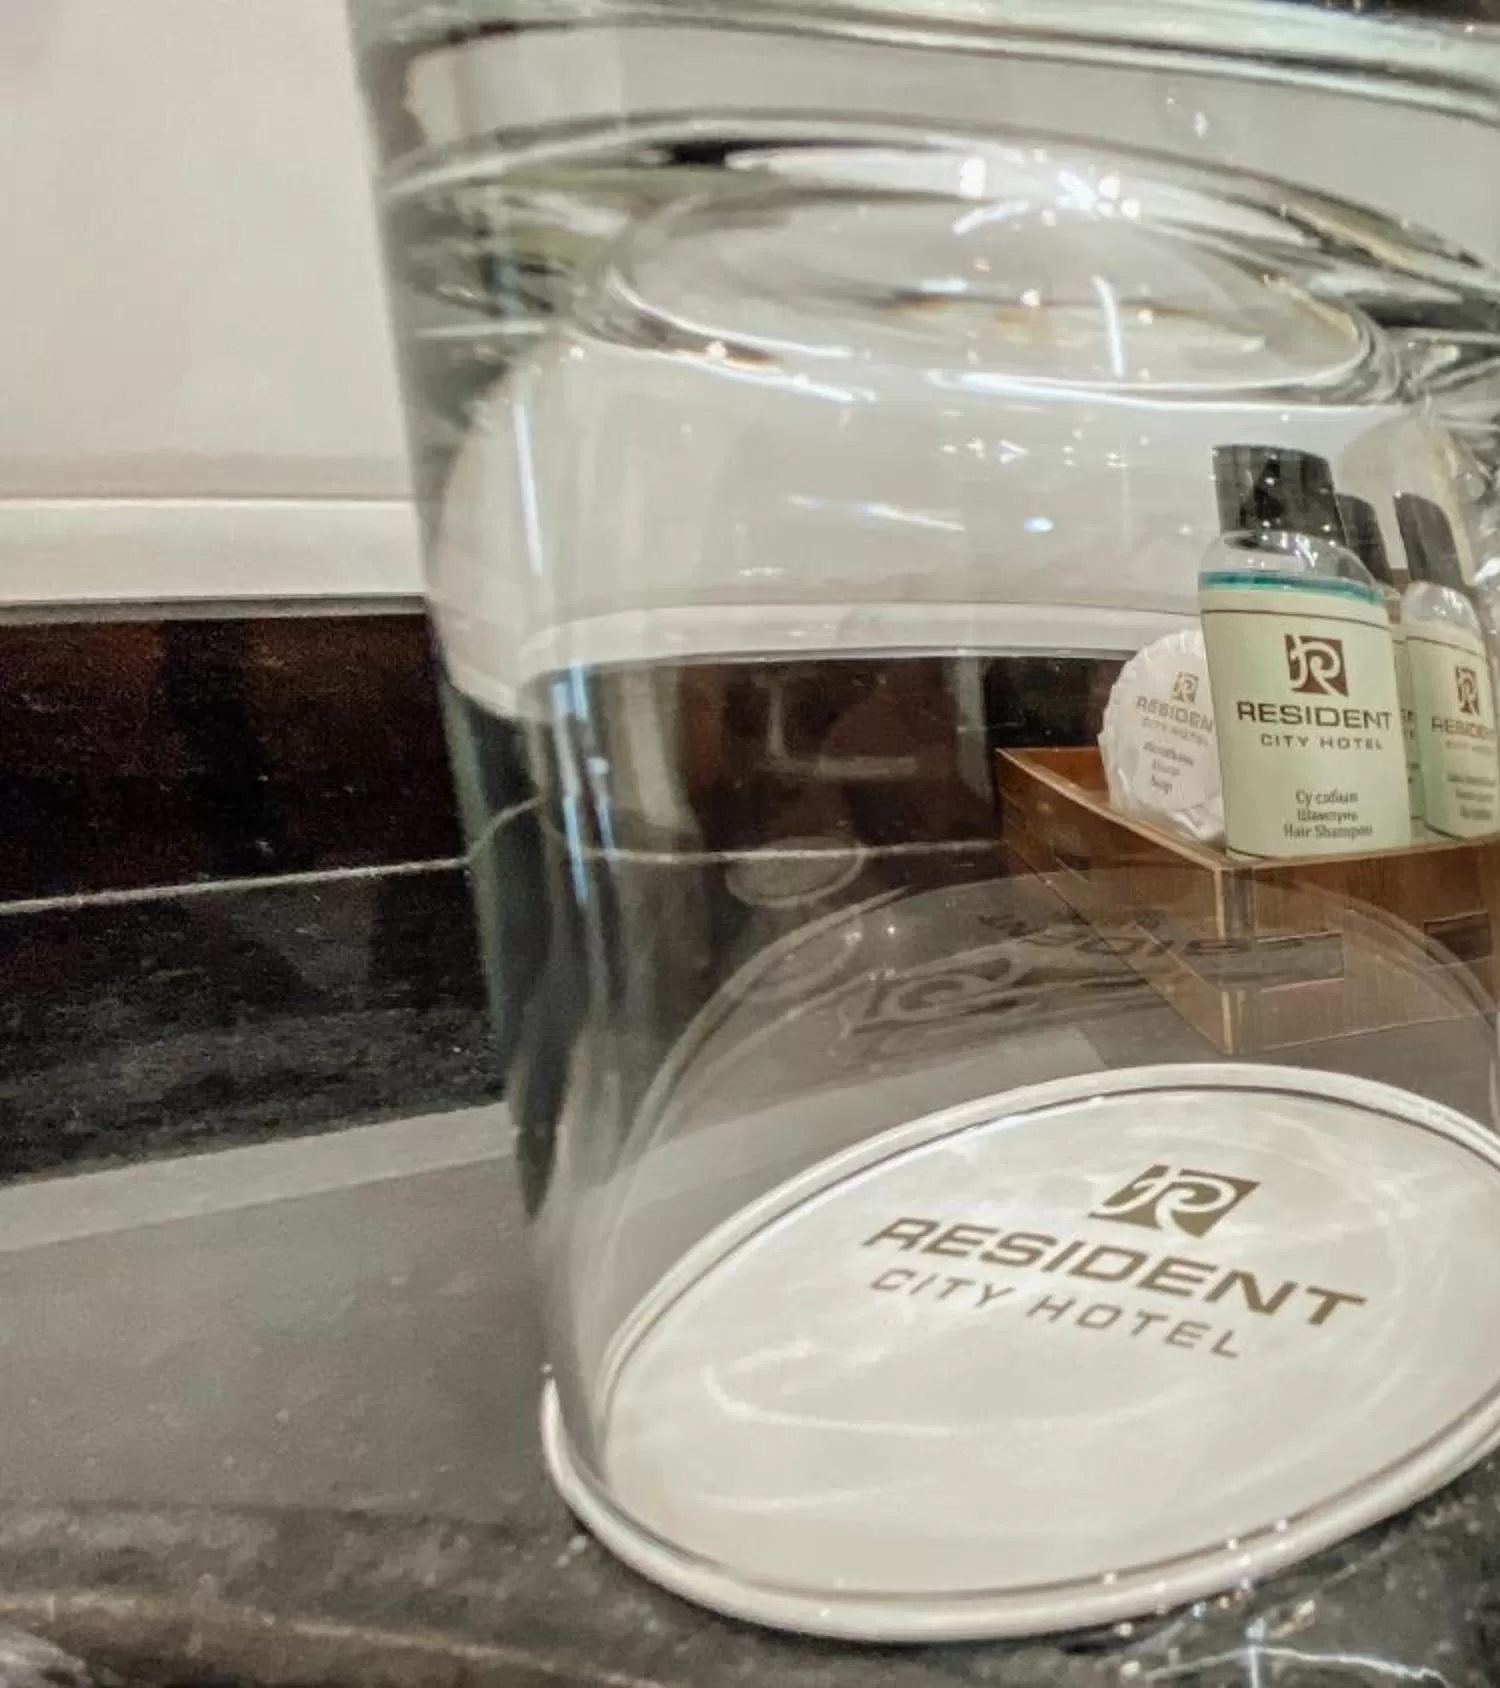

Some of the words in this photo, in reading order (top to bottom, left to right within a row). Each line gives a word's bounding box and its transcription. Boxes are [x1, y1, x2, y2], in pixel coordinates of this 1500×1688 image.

[1135, 695, 1214, 734] RESIDEN
[1236, 701, 1393, 730] RESIDENT
[1260, 733, 1310, 748] CITY
[1319, 735, 1384, 751] HOTEL
[1283, 823, 1312, 837] Hair
[862, 1217, 1367, 1326] RESIDENT
[869, 1267, 1016, 1309] CITY
[1026, 1293, 1241, 1360] HOTEL
